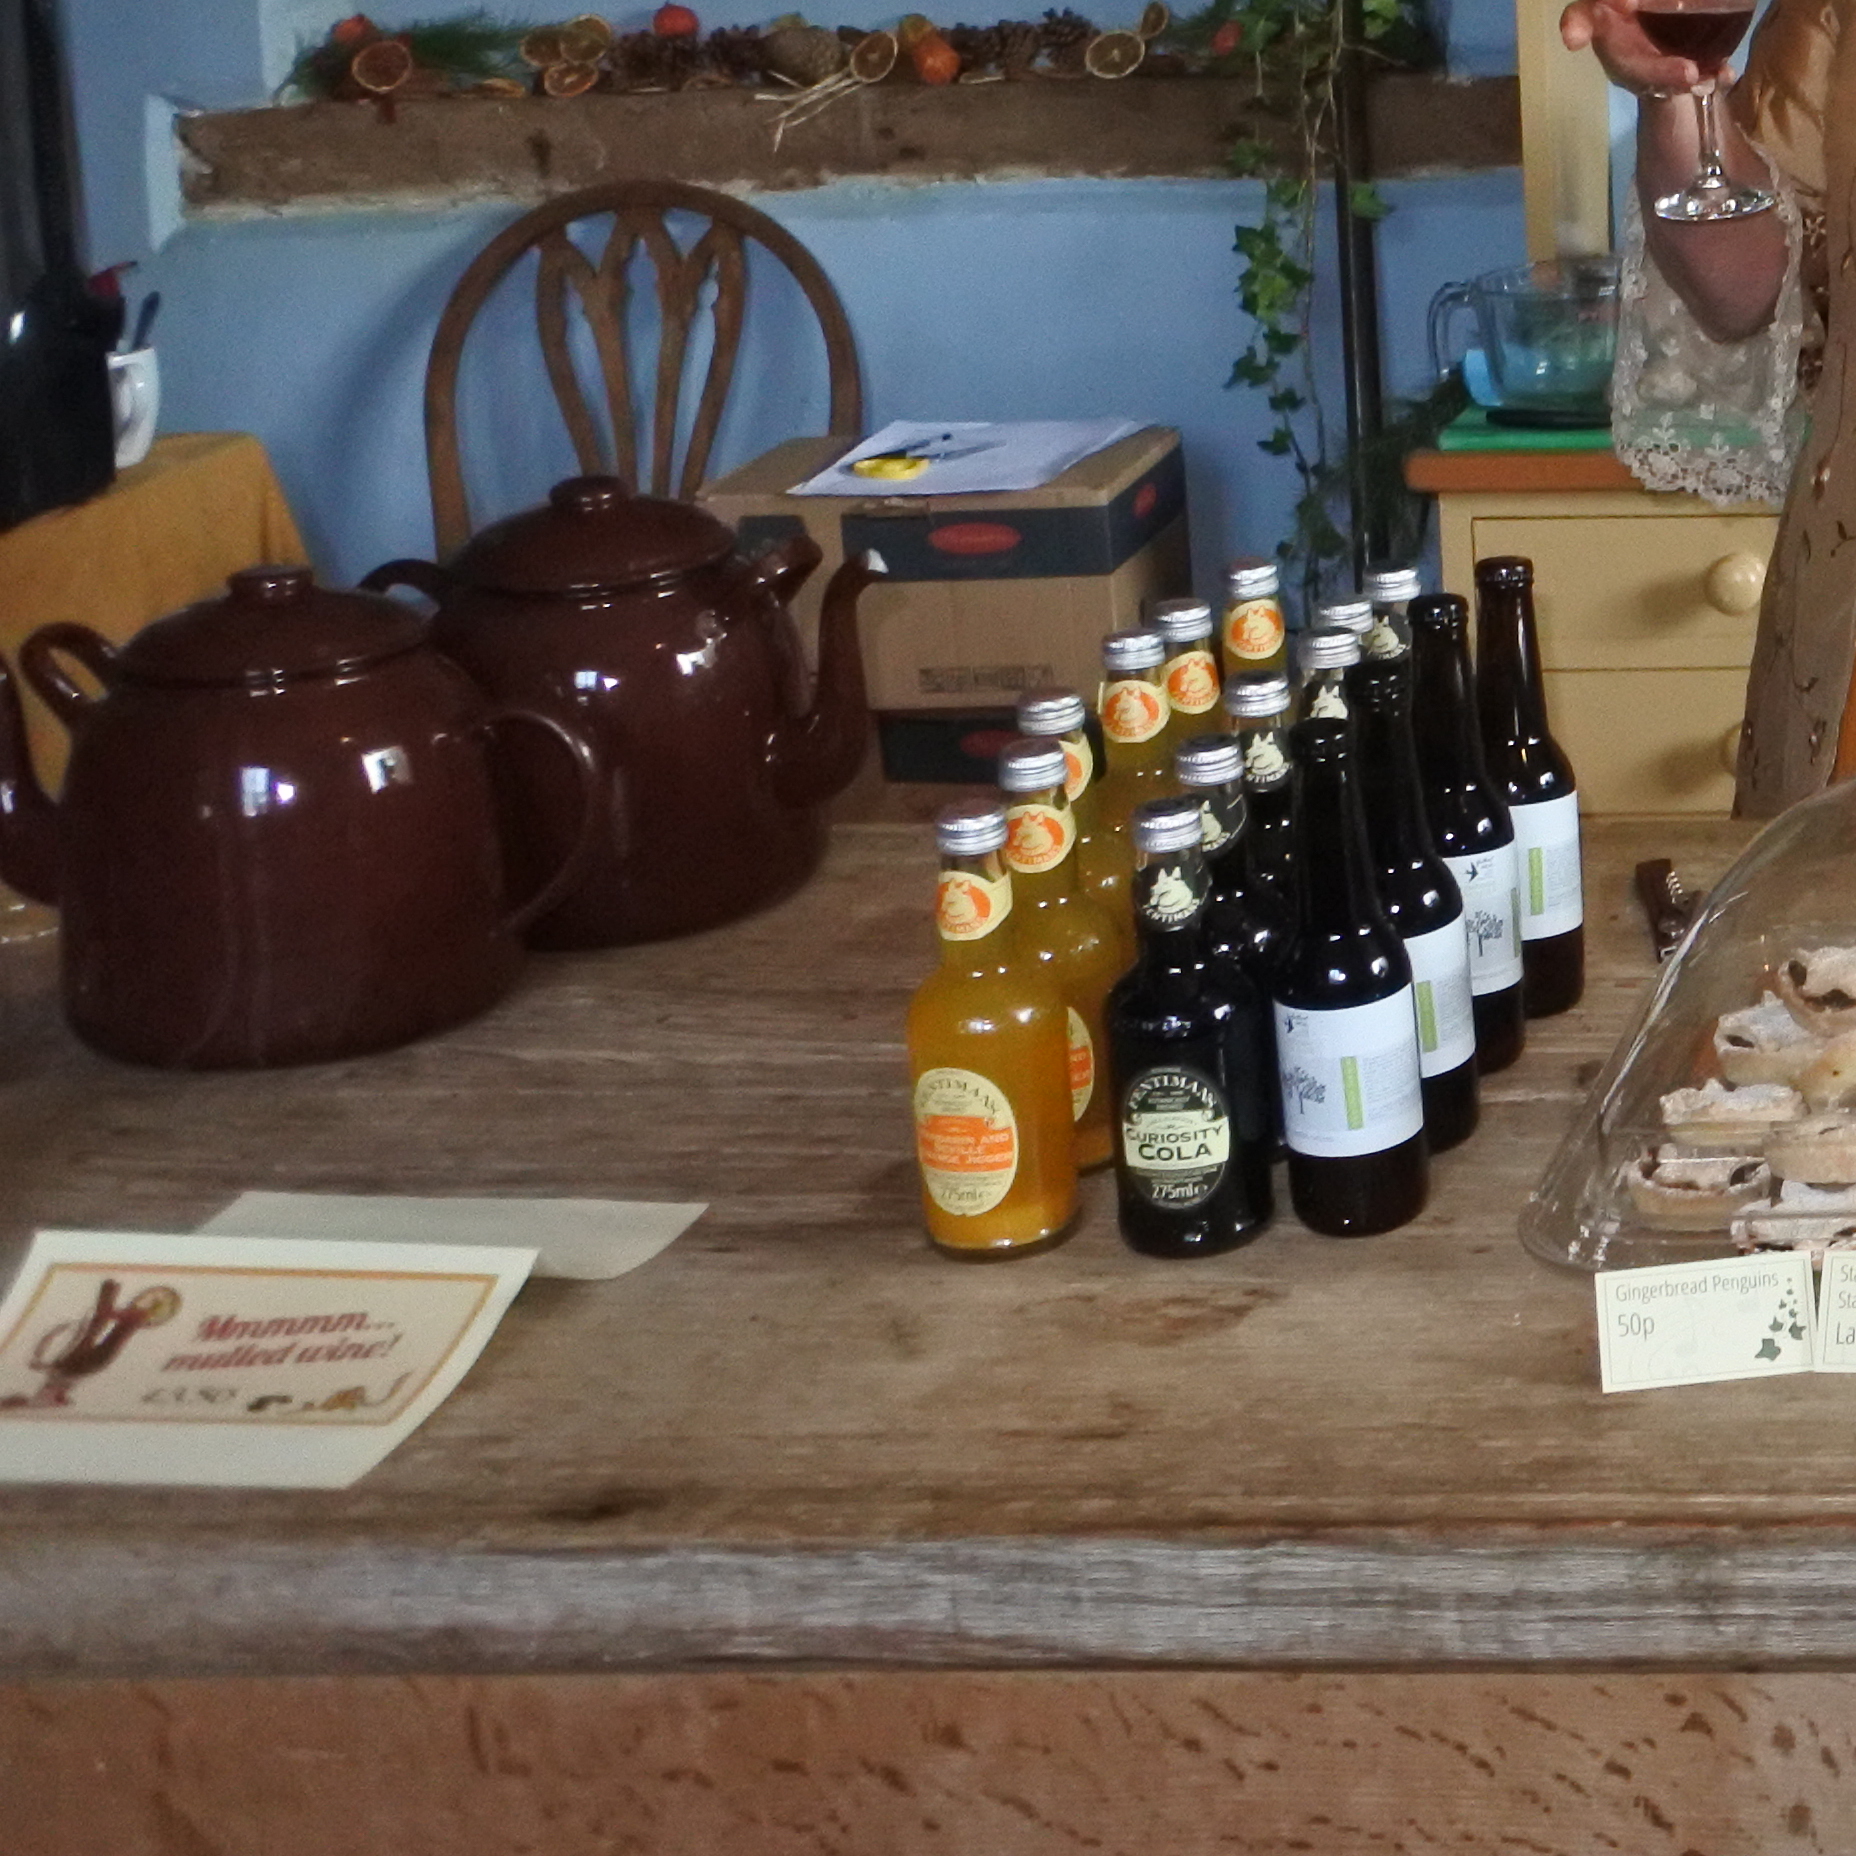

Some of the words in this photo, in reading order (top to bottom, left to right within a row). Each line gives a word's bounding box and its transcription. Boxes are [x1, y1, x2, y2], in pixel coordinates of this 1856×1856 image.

[1126, 1125, 1223, 1144] CURIOSITY
[1138, 1143, 1213, 1161] COLA
[1615, 1279, 1708, 1304] Gingerbread
[1712, 1270, 1779, 1293] Penguins
[1618, 1312, 1655, 1341] 50p
